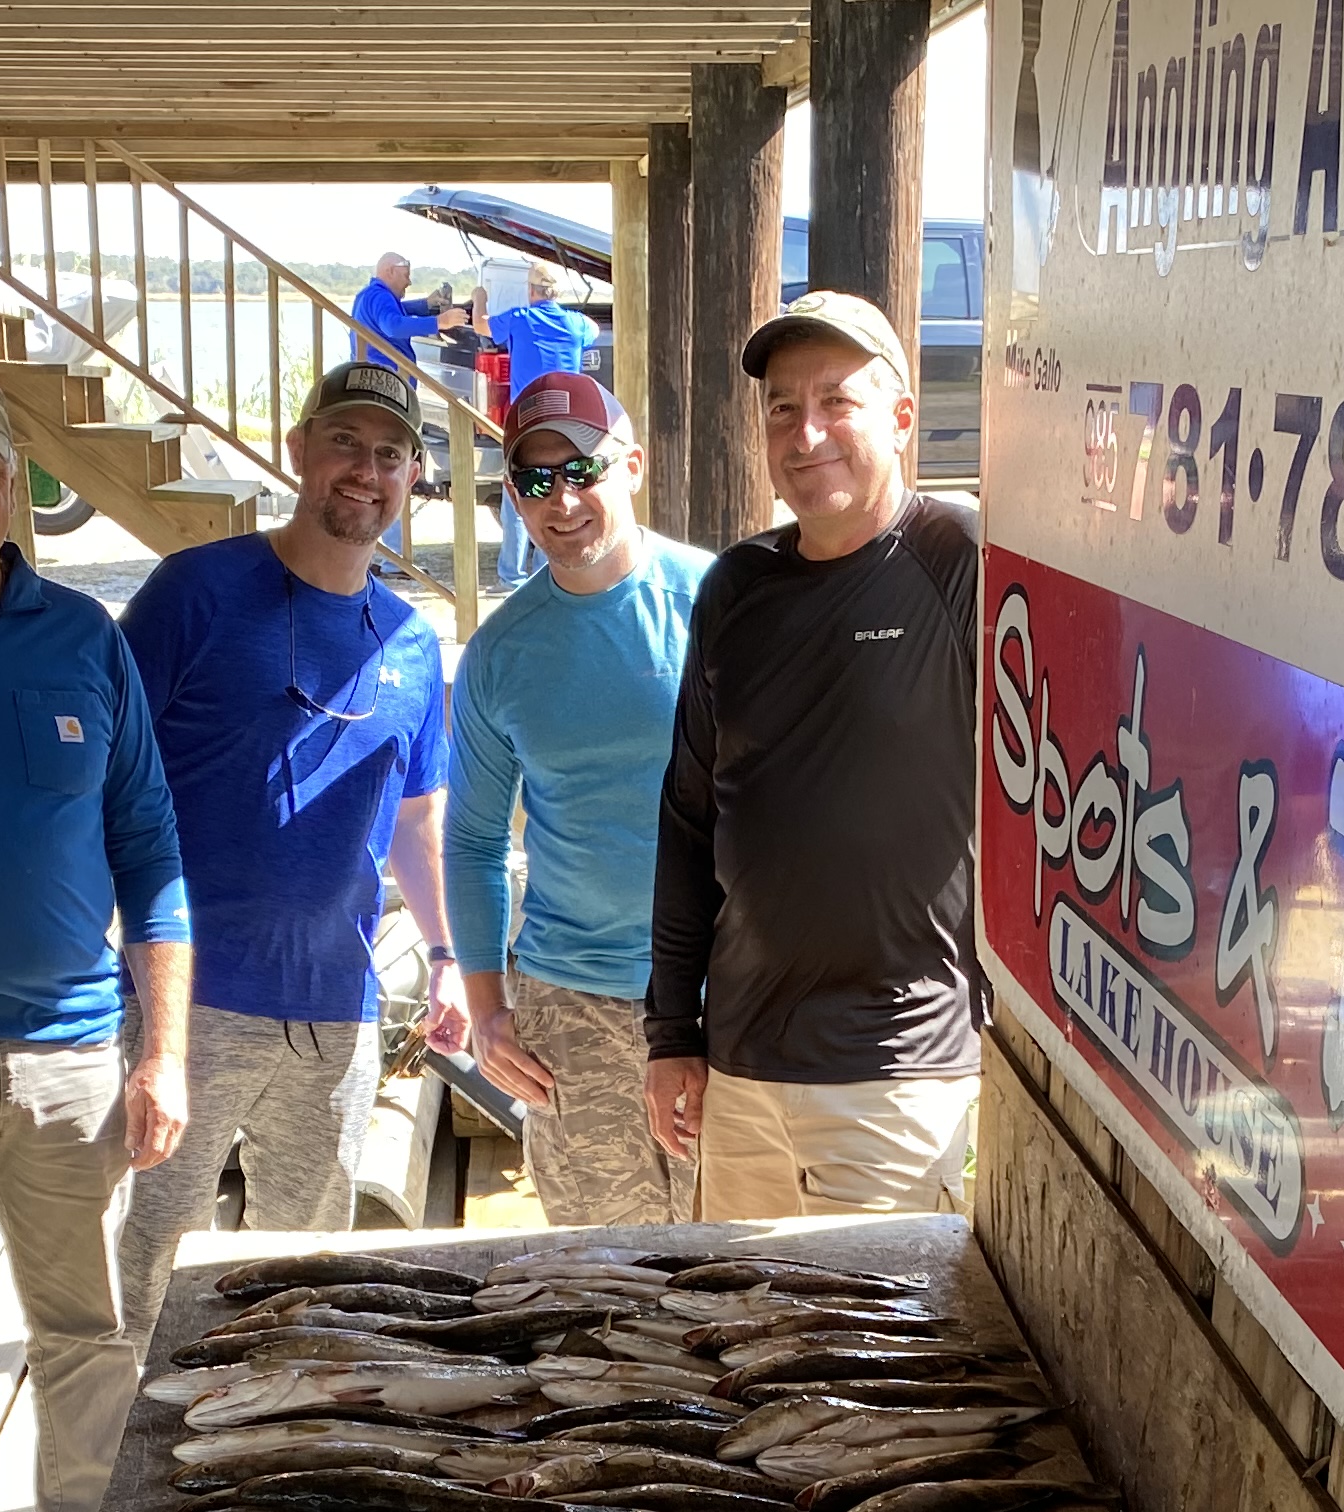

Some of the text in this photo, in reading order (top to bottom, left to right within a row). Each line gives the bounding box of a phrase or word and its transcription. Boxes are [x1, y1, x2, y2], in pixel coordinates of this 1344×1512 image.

[1097, 0, 1282, 277] Angling
[1033, 347, 1062, 393] Gallo
[1083, 397, 1120, 494] 985
[854, 628, 905, 641] BALEAF
[992, 588, 1200, 955] Spots
[1218, 765, 1278, 1064] &
[1058, 916, 1287, 1219] LAKE HOUSE
